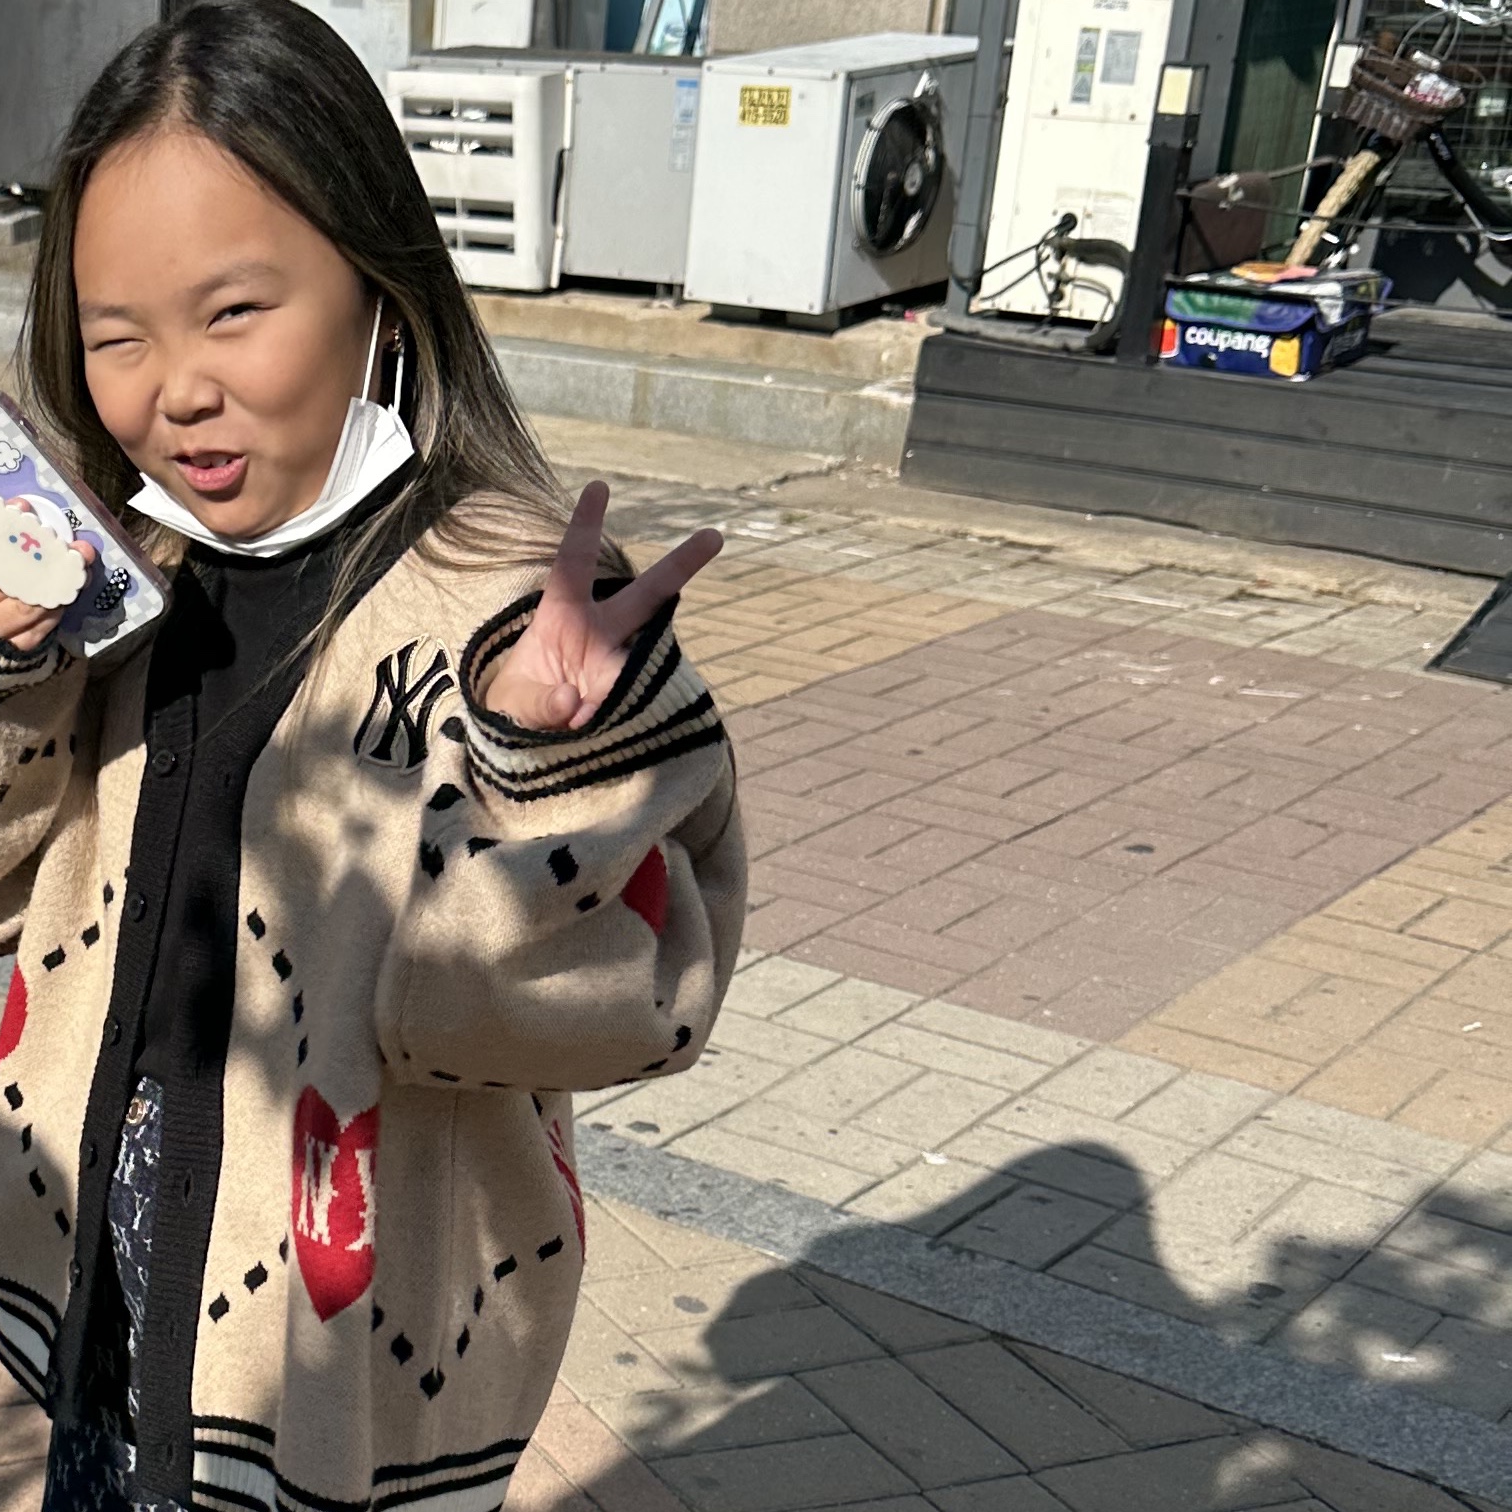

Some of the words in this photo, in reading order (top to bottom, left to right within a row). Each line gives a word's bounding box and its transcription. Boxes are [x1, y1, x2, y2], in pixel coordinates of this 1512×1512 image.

[1185, 326, 1271, 358] coupang
[354, 638, 456, 769] NY
[135, 1191, 151, 1230] Y
